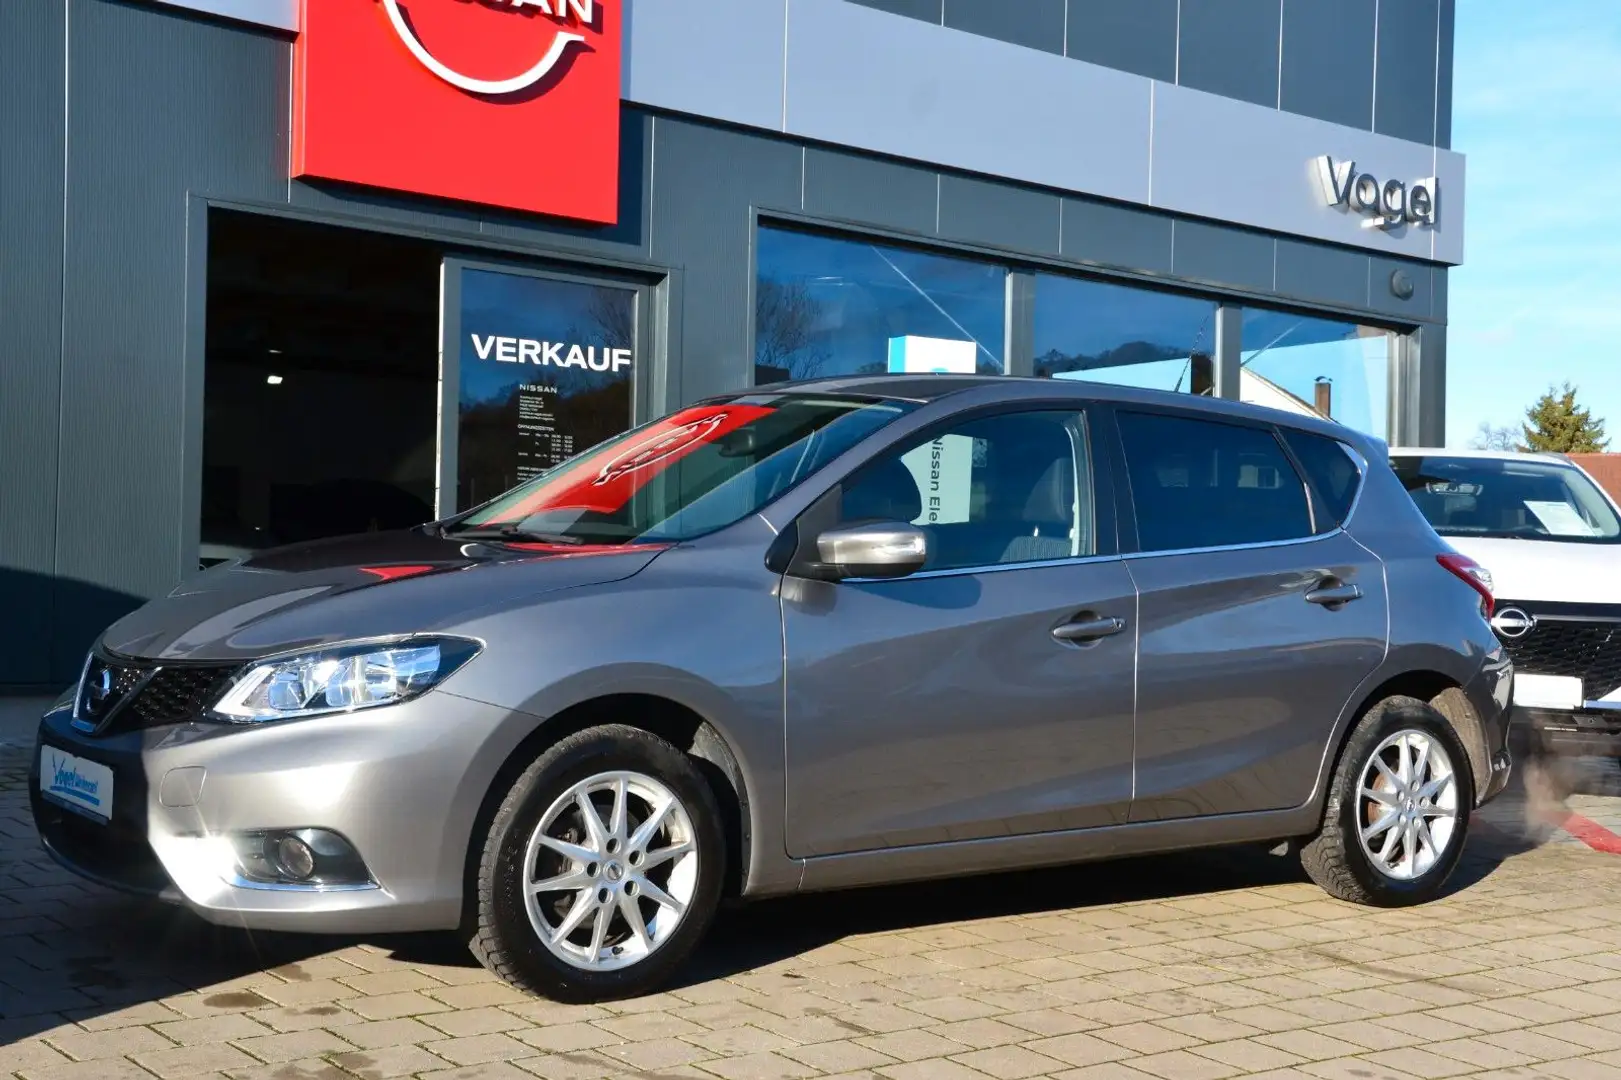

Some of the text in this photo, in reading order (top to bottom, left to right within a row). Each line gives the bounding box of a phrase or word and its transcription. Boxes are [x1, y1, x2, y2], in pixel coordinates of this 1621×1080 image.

[1317, 155, 1439, 231] Vogel
[471, 333, 632, 372] VERKAUF
[519, 383, 558, 394] NISSAN
